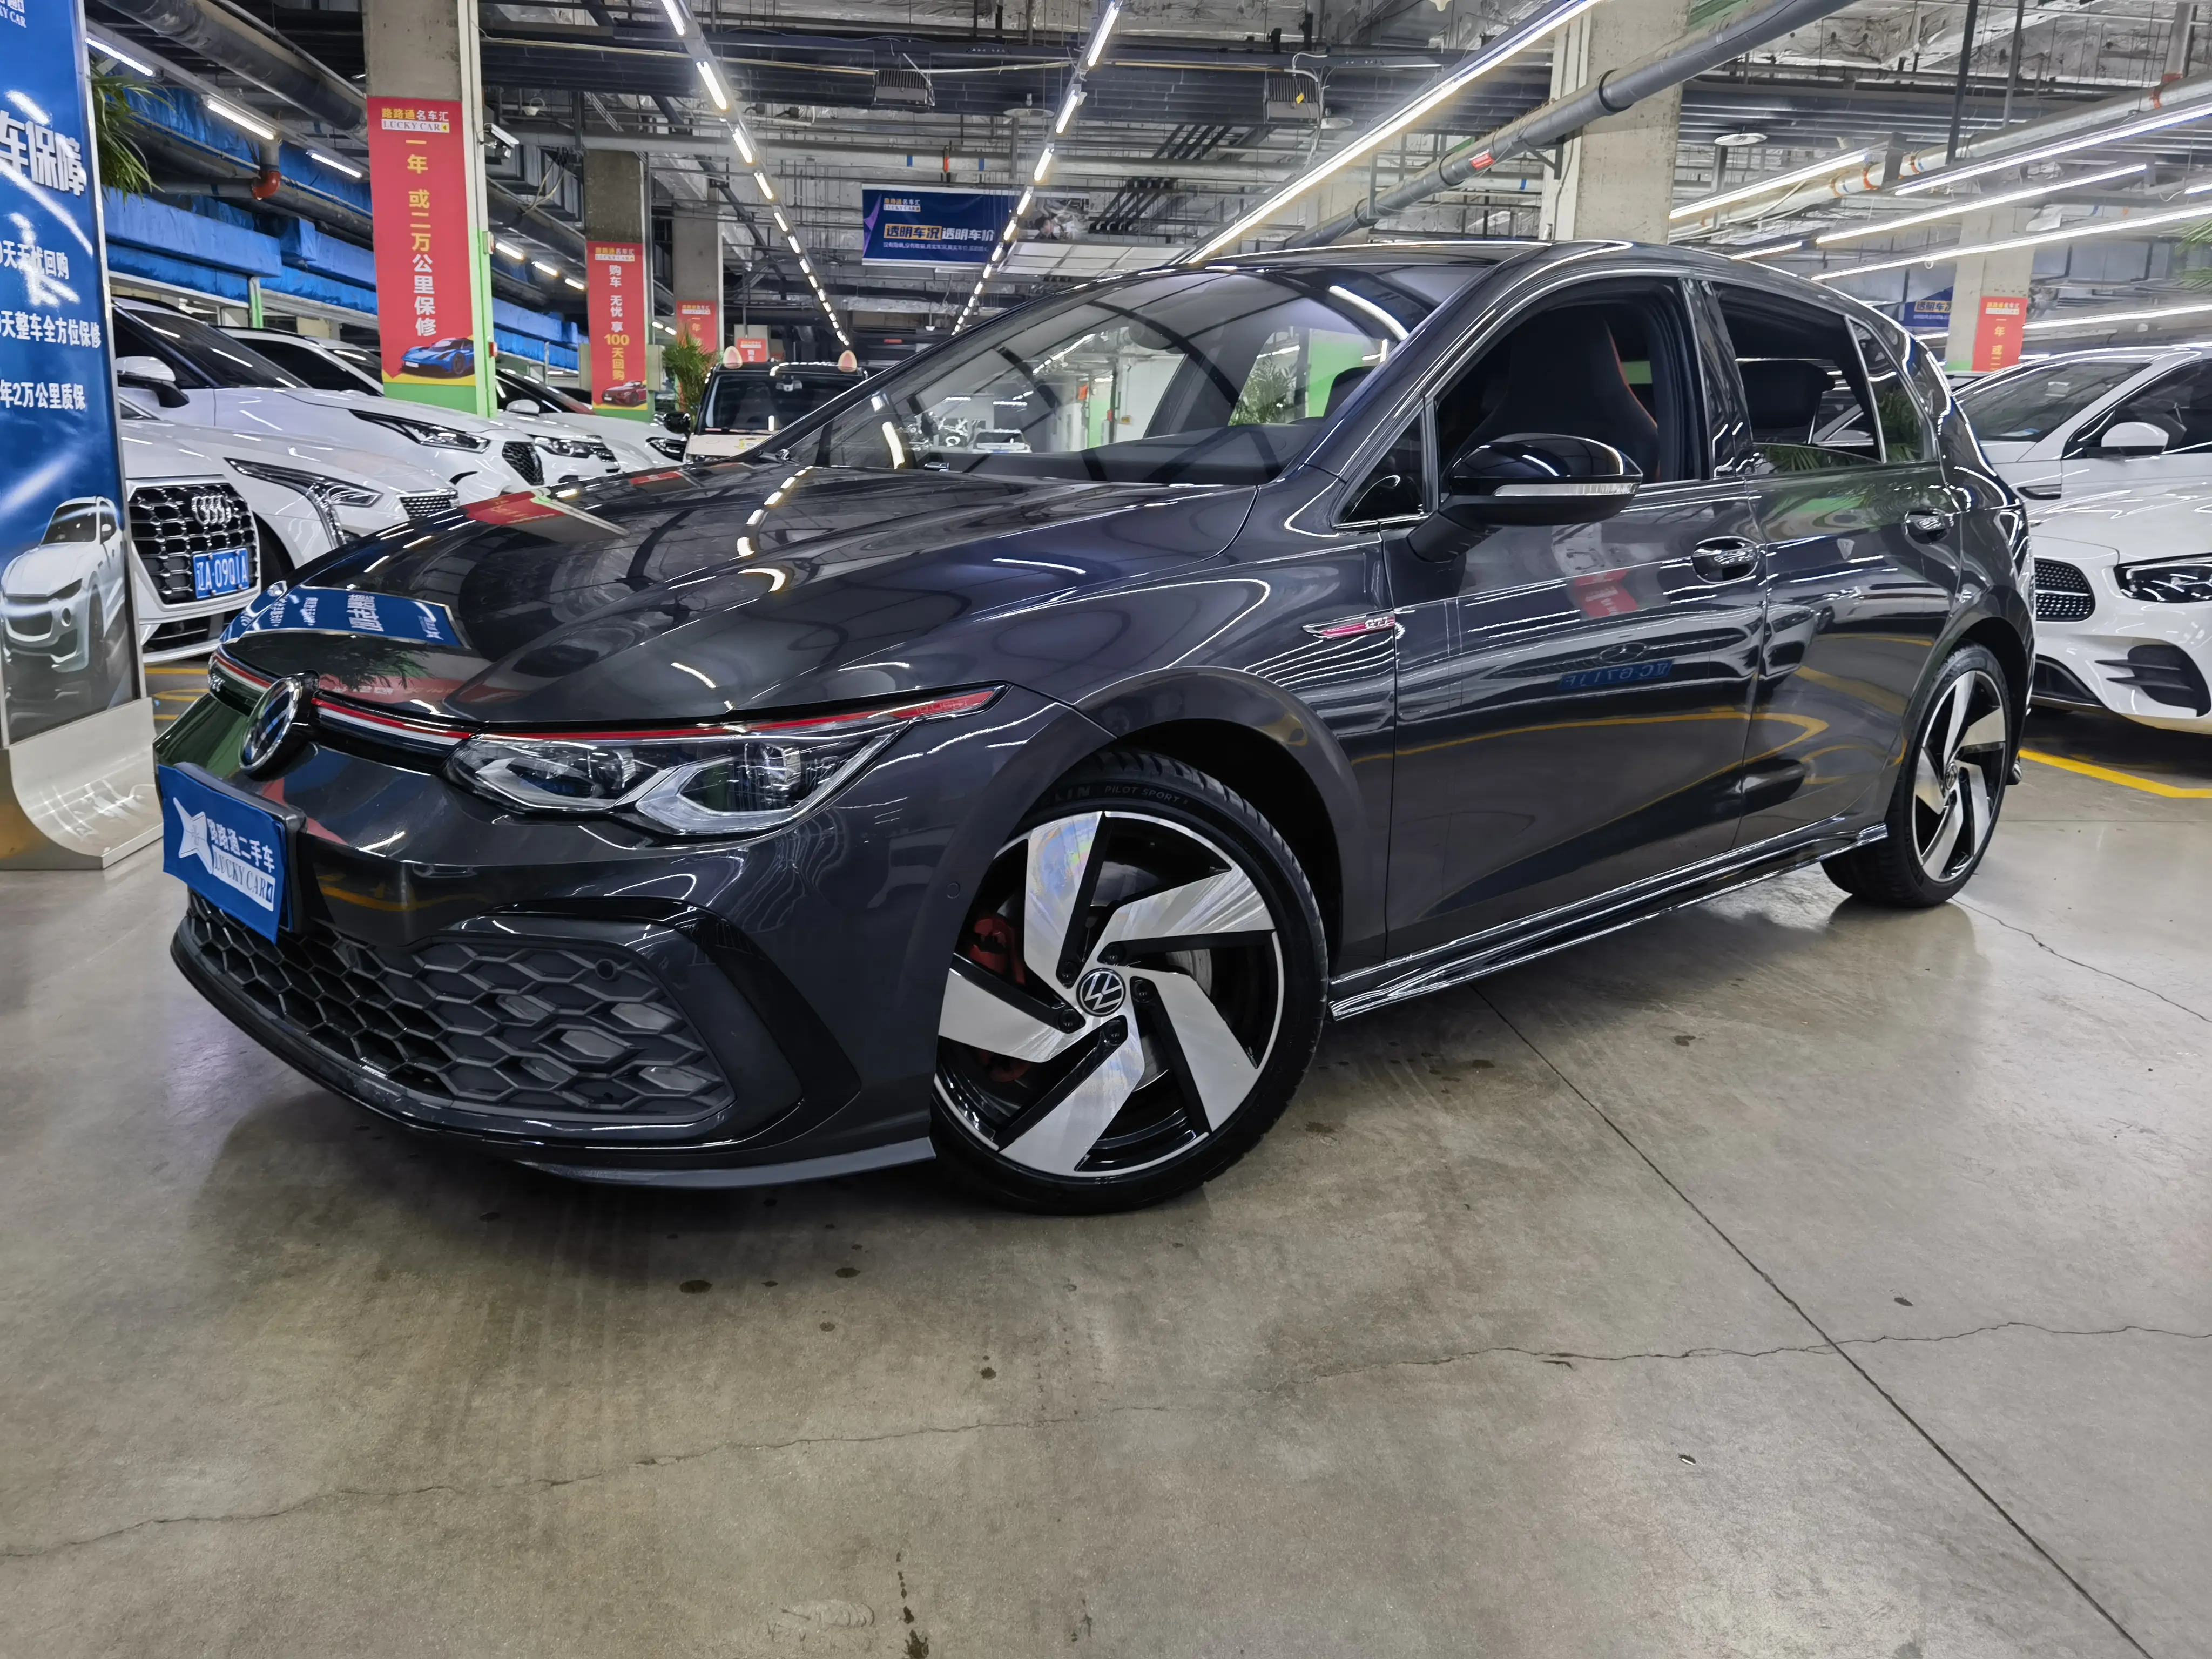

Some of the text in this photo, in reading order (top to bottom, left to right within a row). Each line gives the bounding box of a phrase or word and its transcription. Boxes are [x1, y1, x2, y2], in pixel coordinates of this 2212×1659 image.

[9, 11, 27, 28] CAR
[383, 120, 440, 131] LUCKY CAR
[887, 225, 994, 241] 透明车况 透明车价
[0, 310, 102, 348] 天整车全方位保修
[1365, 616, 1388, 629] GTI
[1104, 785, 1138, 794] PILOT
[1141, 788, 1181, 804] SPORT
[214, 852, 245, 886] LUCKY
